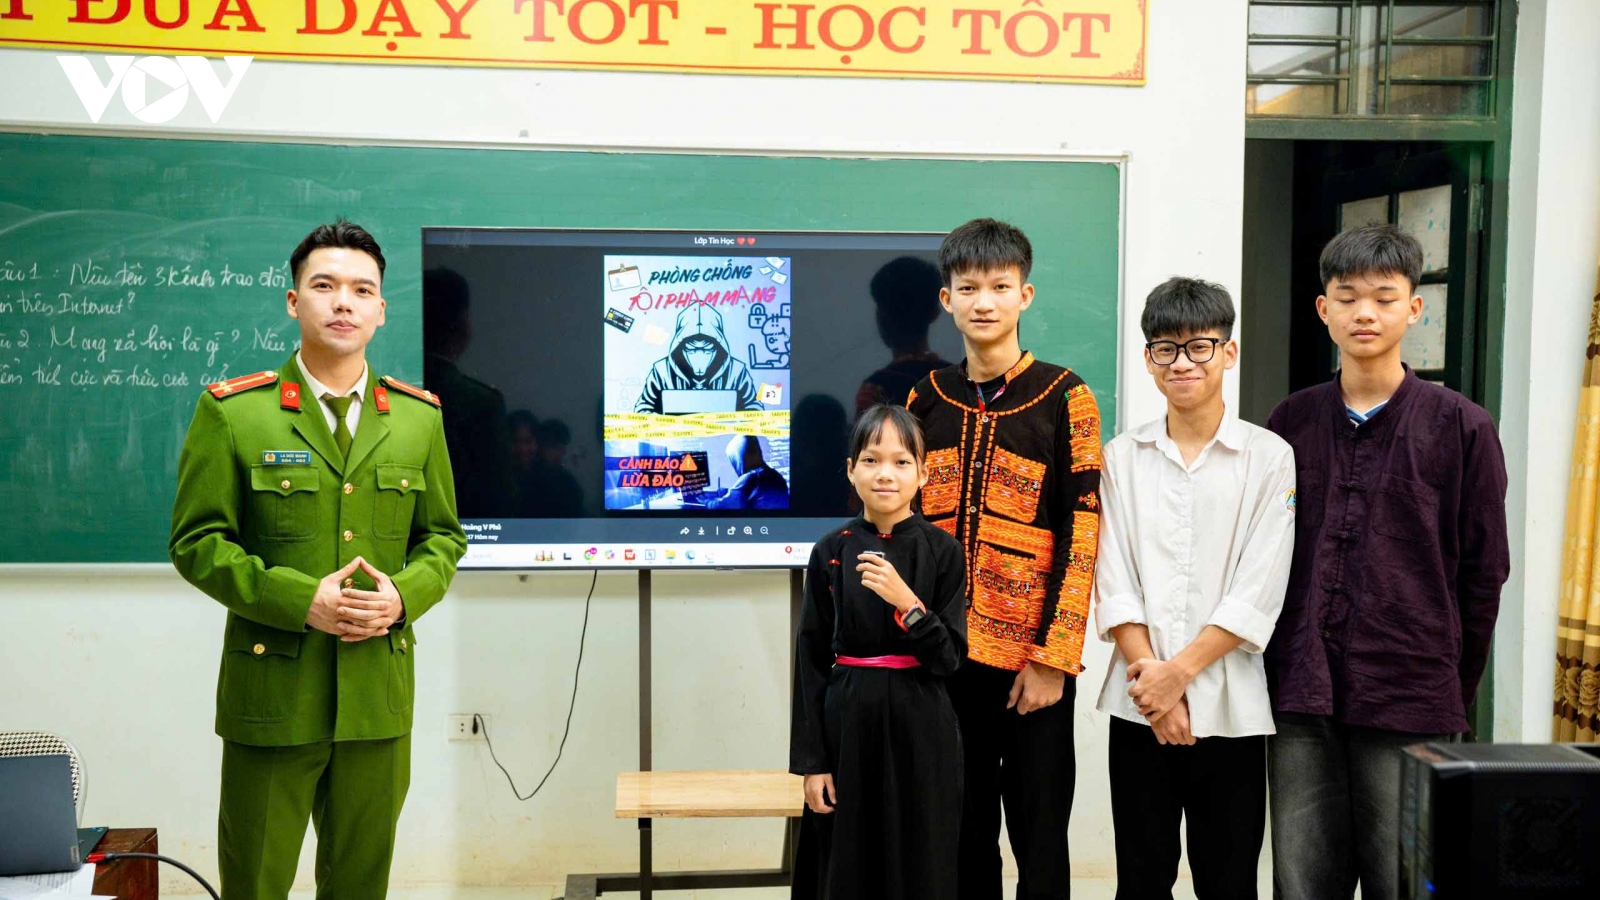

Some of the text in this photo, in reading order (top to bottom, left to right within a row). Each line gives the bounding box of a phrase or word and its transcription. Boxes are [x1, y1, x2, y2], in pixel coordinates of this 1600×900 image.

[296, 0, 480, 51] DẠY
[753, 3, 926, 64] HỌC
[708, 236, 720, 245] Tin
[720, 236, 735, 246] Học
[220, 263, 253, 286] trao
[648, 259, 753, 285] PHÒNG CHỐNG
[628, 285, 776, 315] TỘI PHẠM MẠNG
[618, 456, 680, 470] CẢNH BÁO
[622, 472, 650, 487] LỪA
[652, 470, 685, 487] ĐẢO
